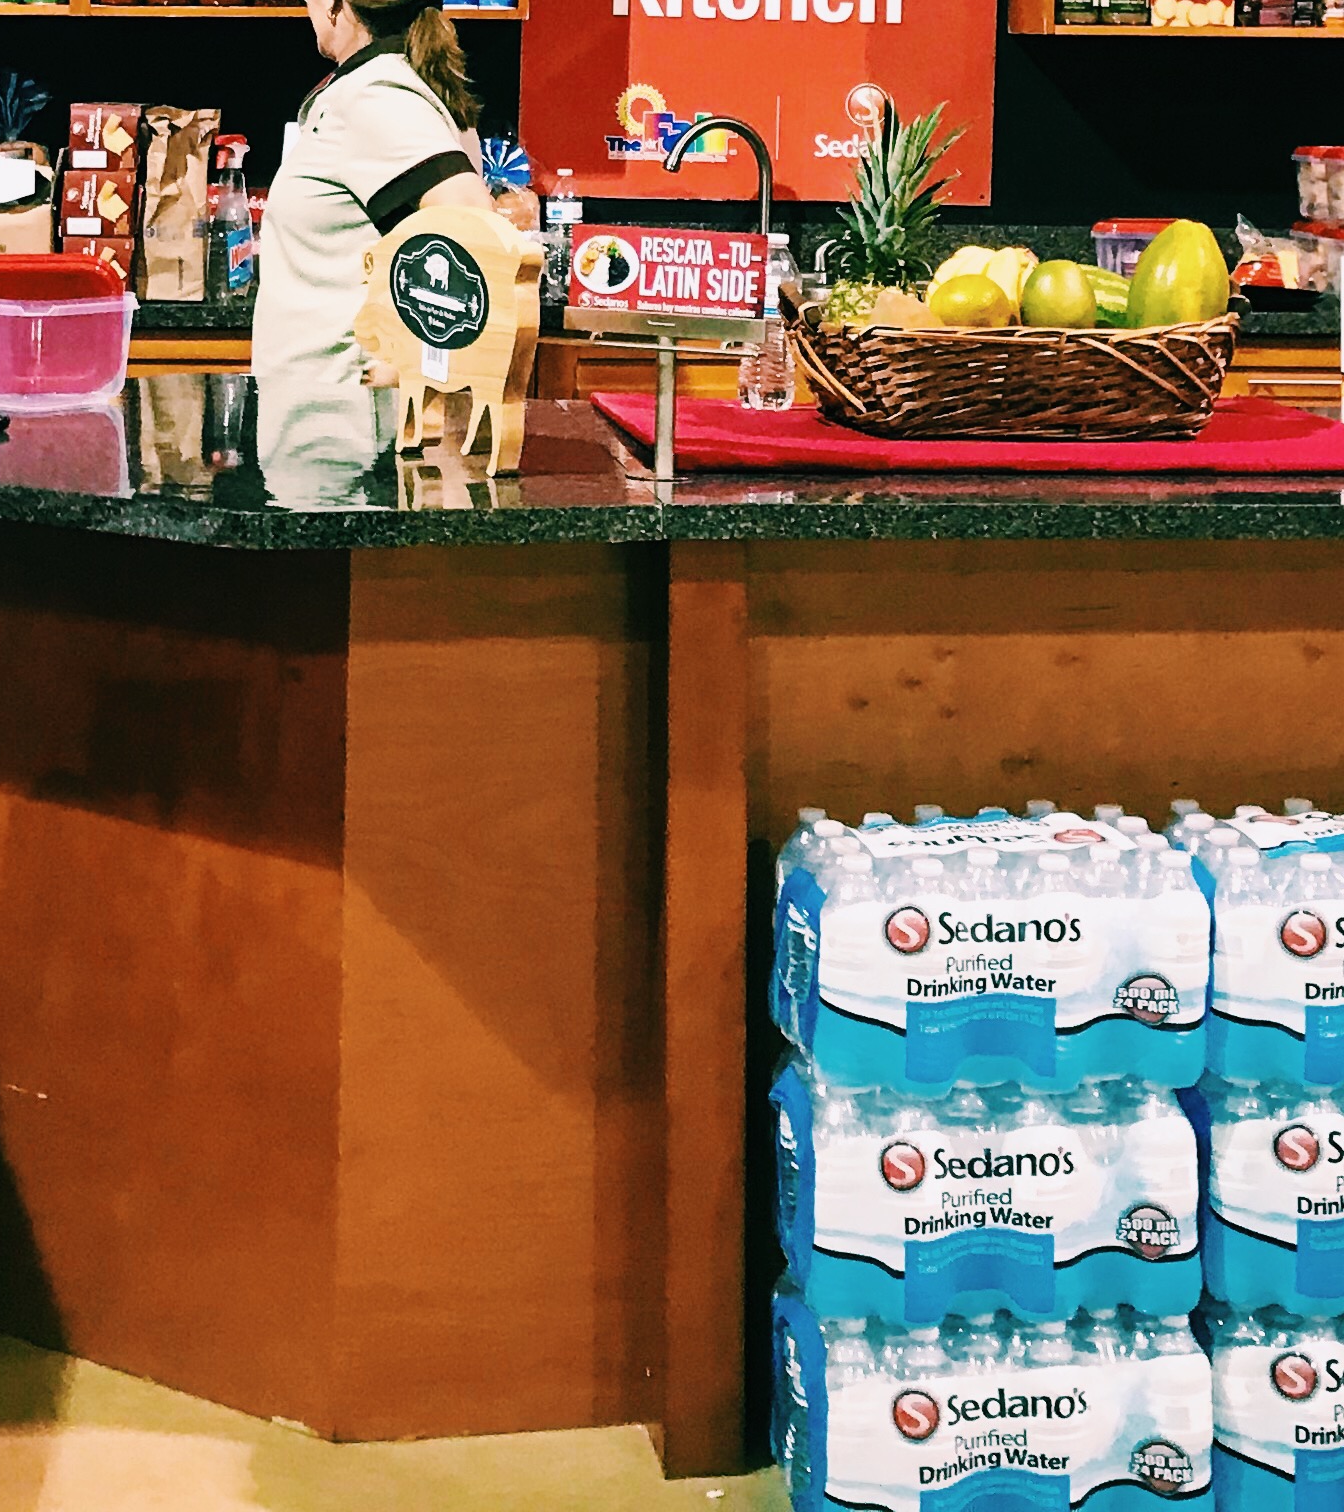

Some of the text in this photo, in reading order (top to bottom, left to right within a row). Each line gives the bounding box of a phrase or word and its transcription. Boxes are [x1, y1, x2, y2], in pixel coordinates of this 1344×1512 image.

[605, 136, 642, 152] The
[640, 236, 715, 266] RESCATA
[638, 263, 761, 304] LATIN SIDE
[937, 911, 1082, 945] Sedano's
[945, 953, 1014, 975] Purified
[906, 971, 1057, 998] Drinking Water
[1115, 986, 1146, 1001] 500
[1113, 997, 1180, 1016] 24 PACK
[933, 1145, 1075, 1182] Sedano's
[940, 1186, 1014, 1210] Purified
[903, 1206, 1054, 1236] Drinking Water
[946, 1387, 1089, 1427] Sedano's
[954, 1429, 1029, 1450] Purified
[918, 1448, 1070, 1486] Drinking Water
